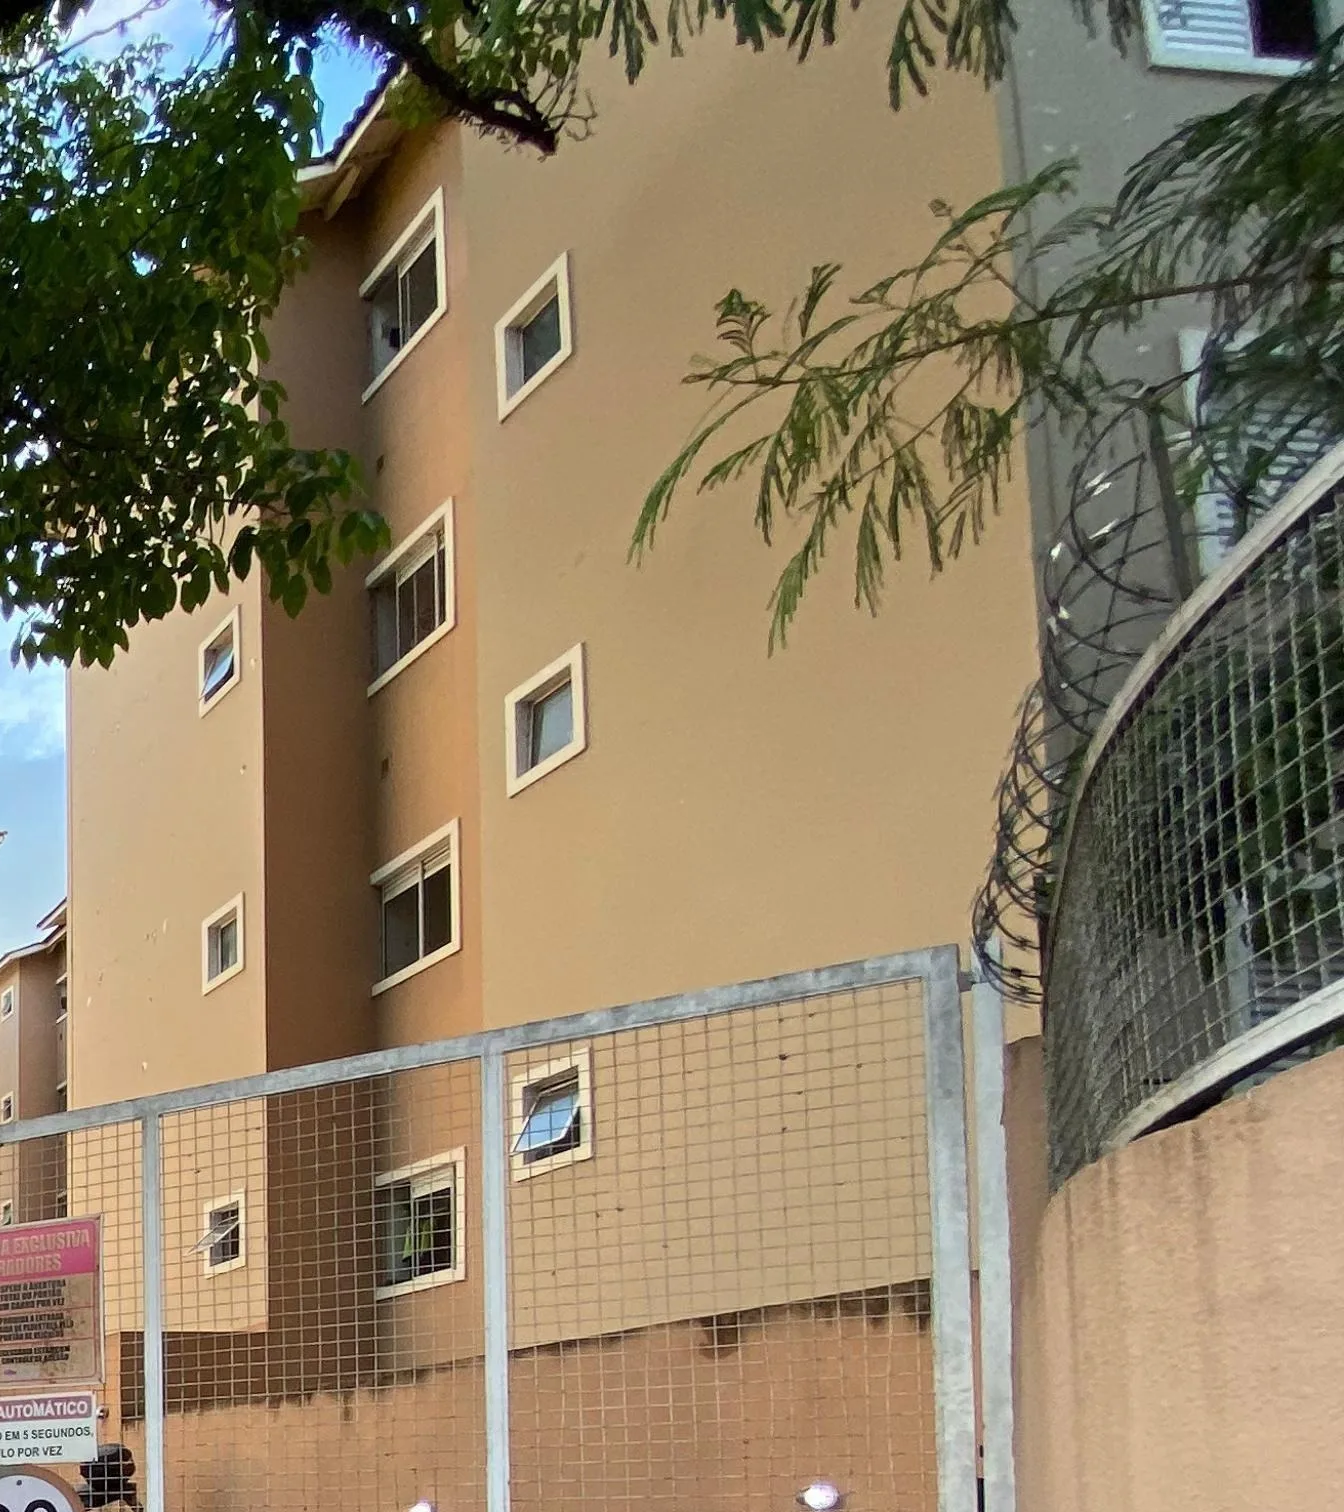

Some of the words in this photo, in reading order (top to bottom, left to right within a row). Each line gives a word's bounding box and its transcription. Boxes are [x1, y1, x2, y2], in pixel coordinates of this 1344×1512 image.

[14, 1229, 91, 1254] EXCLUSIVA
[4, 1430, 20, 1441] EM
[23, 1429, 29, 1440] 5
[31, 1426, 94, 1440] SEGUNDOS,
[17, 1447, 40, 1458] POR
[42, 1446, 63, 1456] VEZ
